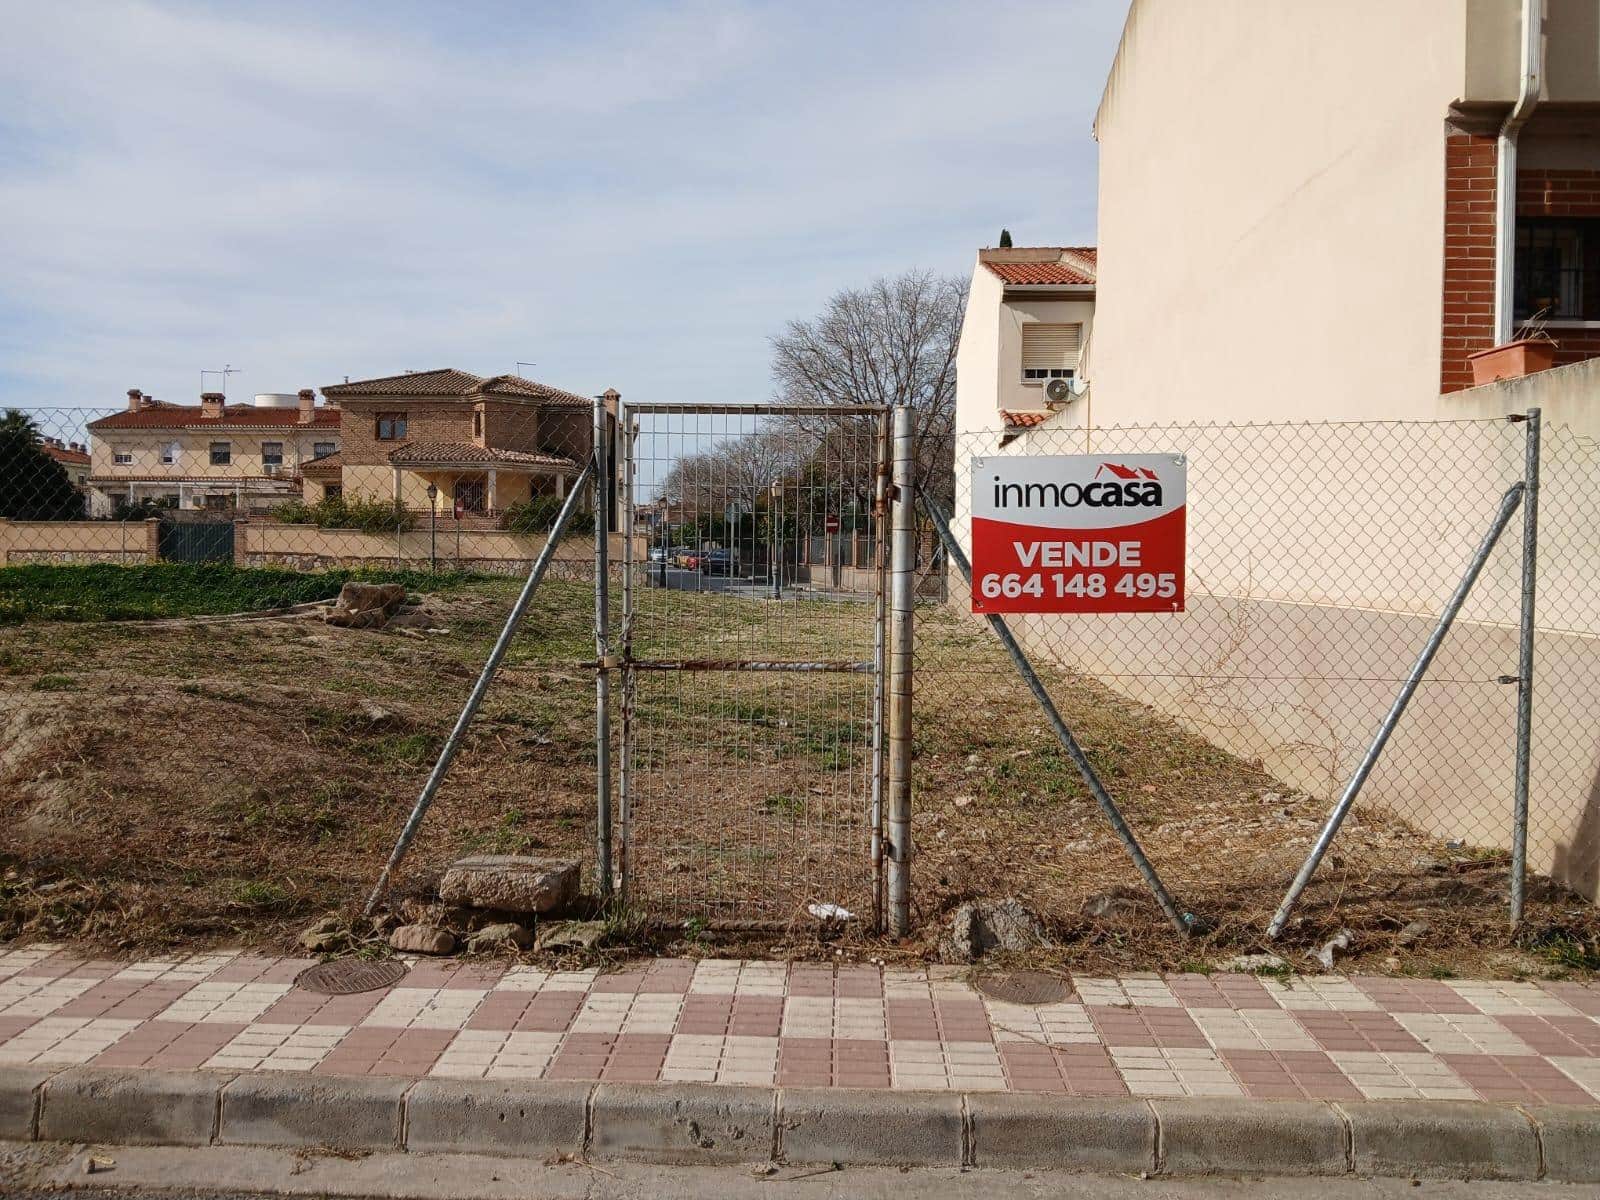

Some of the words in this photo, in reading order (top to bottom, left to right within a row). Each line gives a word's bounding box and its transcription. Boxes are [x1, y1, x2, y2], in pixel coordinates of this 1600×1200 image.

[994, 475, 1163, 508] inmocasa
[1013, 541, 1142, 568] VENDE
[981, 573, 1043, 598] 664
[1052, 573, 1107, 598] 148
[1114, 573, 1177, 598] 495
